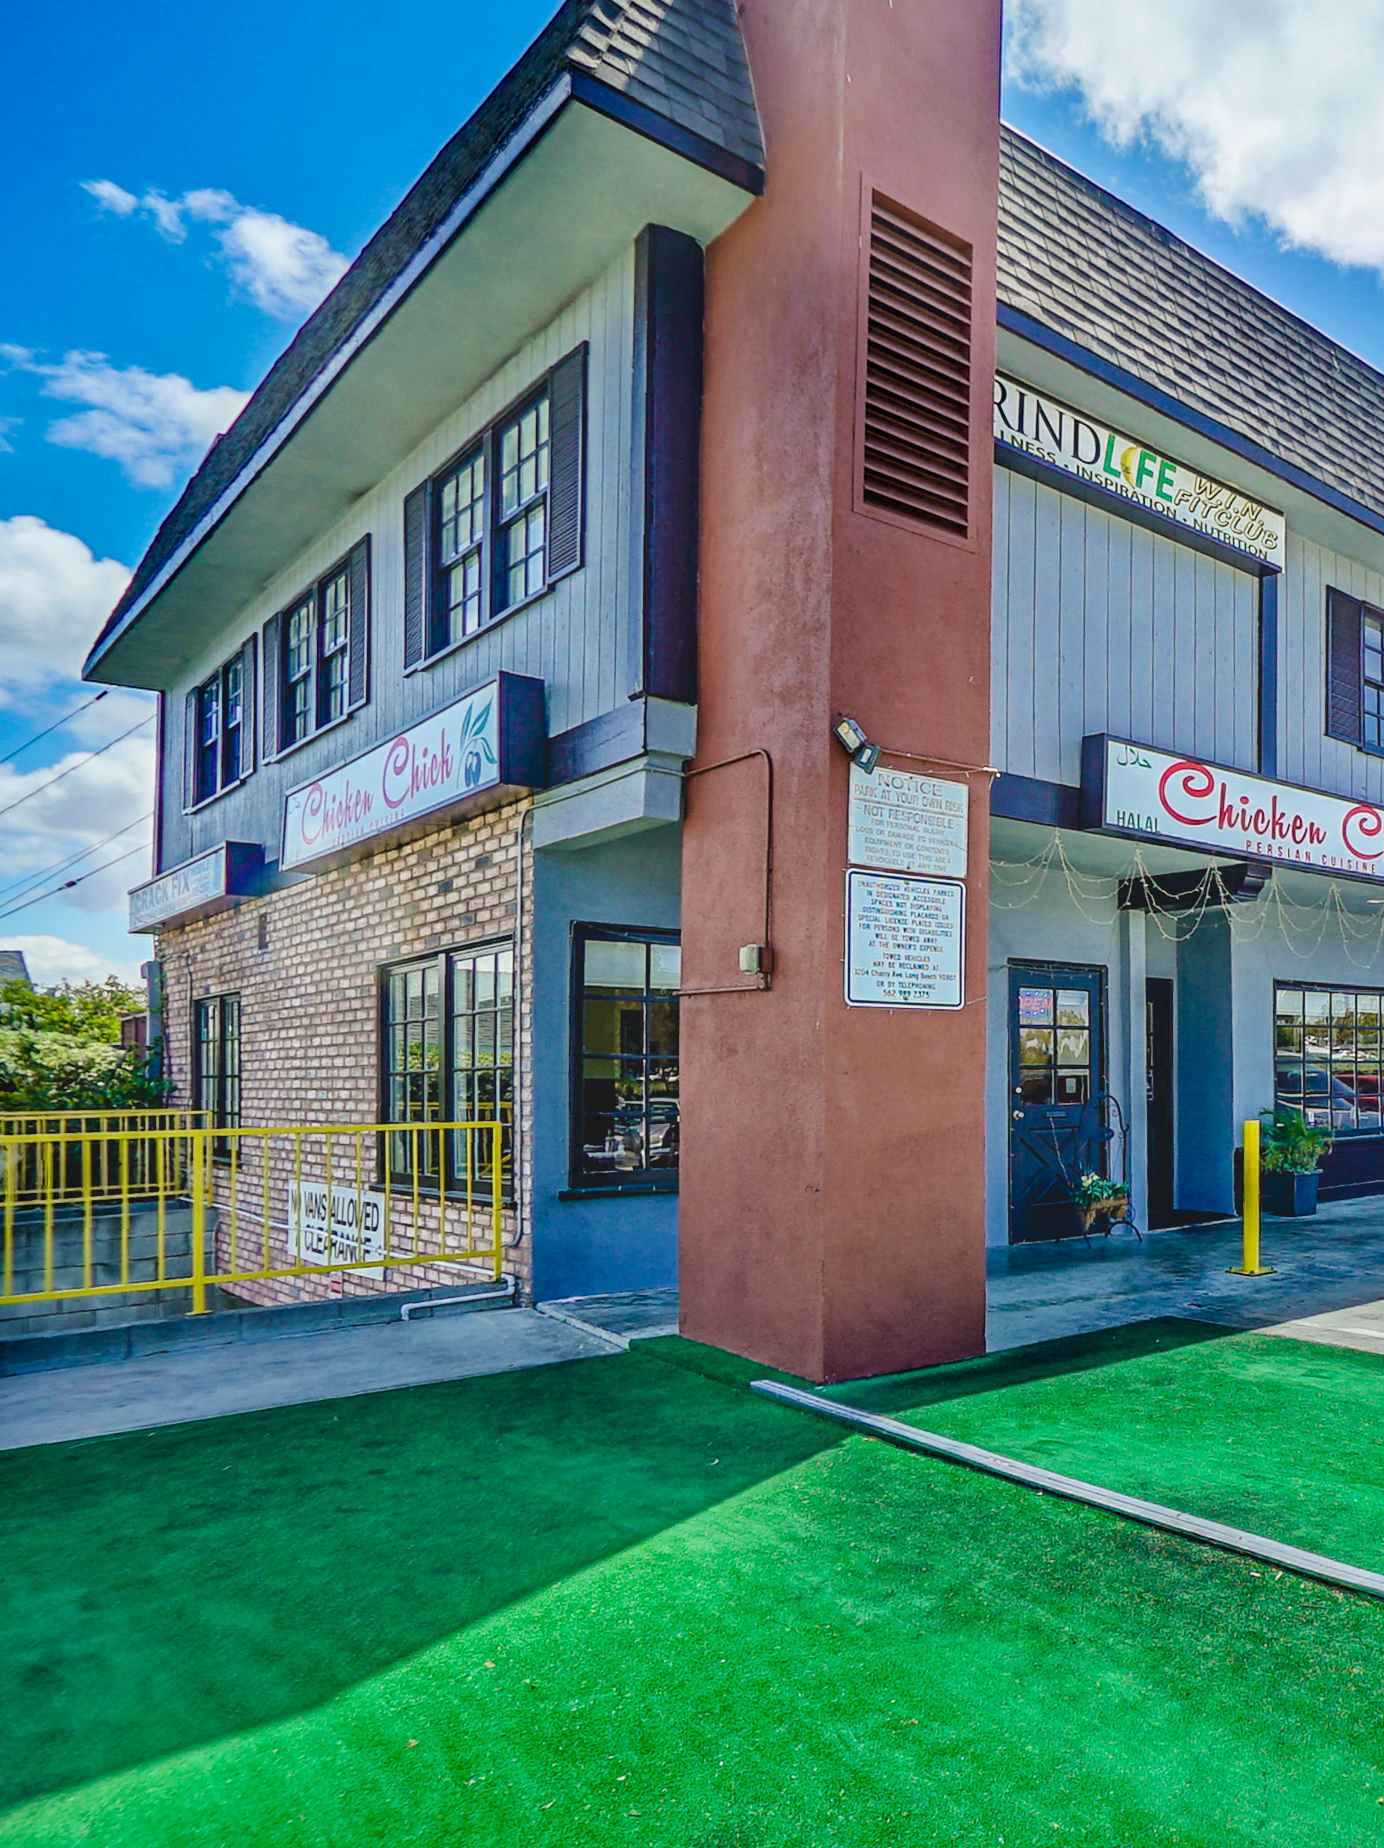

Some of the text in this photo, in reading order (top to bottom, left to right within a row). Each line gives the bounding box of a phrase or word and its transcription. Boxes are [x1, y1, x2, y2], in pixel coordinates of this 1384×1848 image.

[1076, 464, 1177, 521] INSPIRATION
[1193, 516, 1268, 561] NUTRITION
[1116, 745, 1153, 769] حلال
[302, 728, 453, 845] Chicken Chick
[854, 783, 878, 799] PARK
[881, 789, 892, 801] AT
[896, 792, 919, 806] YOUR
[921, 795, 943, 809] OWN
[878, 774, 943, 798] NOTICE
[864, 804, 956, 830] NOT RESPONSIBLE
[1159, 760, 1327, 845] Chicken
[1117, 810, 1159, 834] HALAL
[1245, 839, 1377, 874] PERSIAN CUISINE
[304, 1192, 326, 1221] VANS
[331, 1196, 379, 1231] ALLOWED
